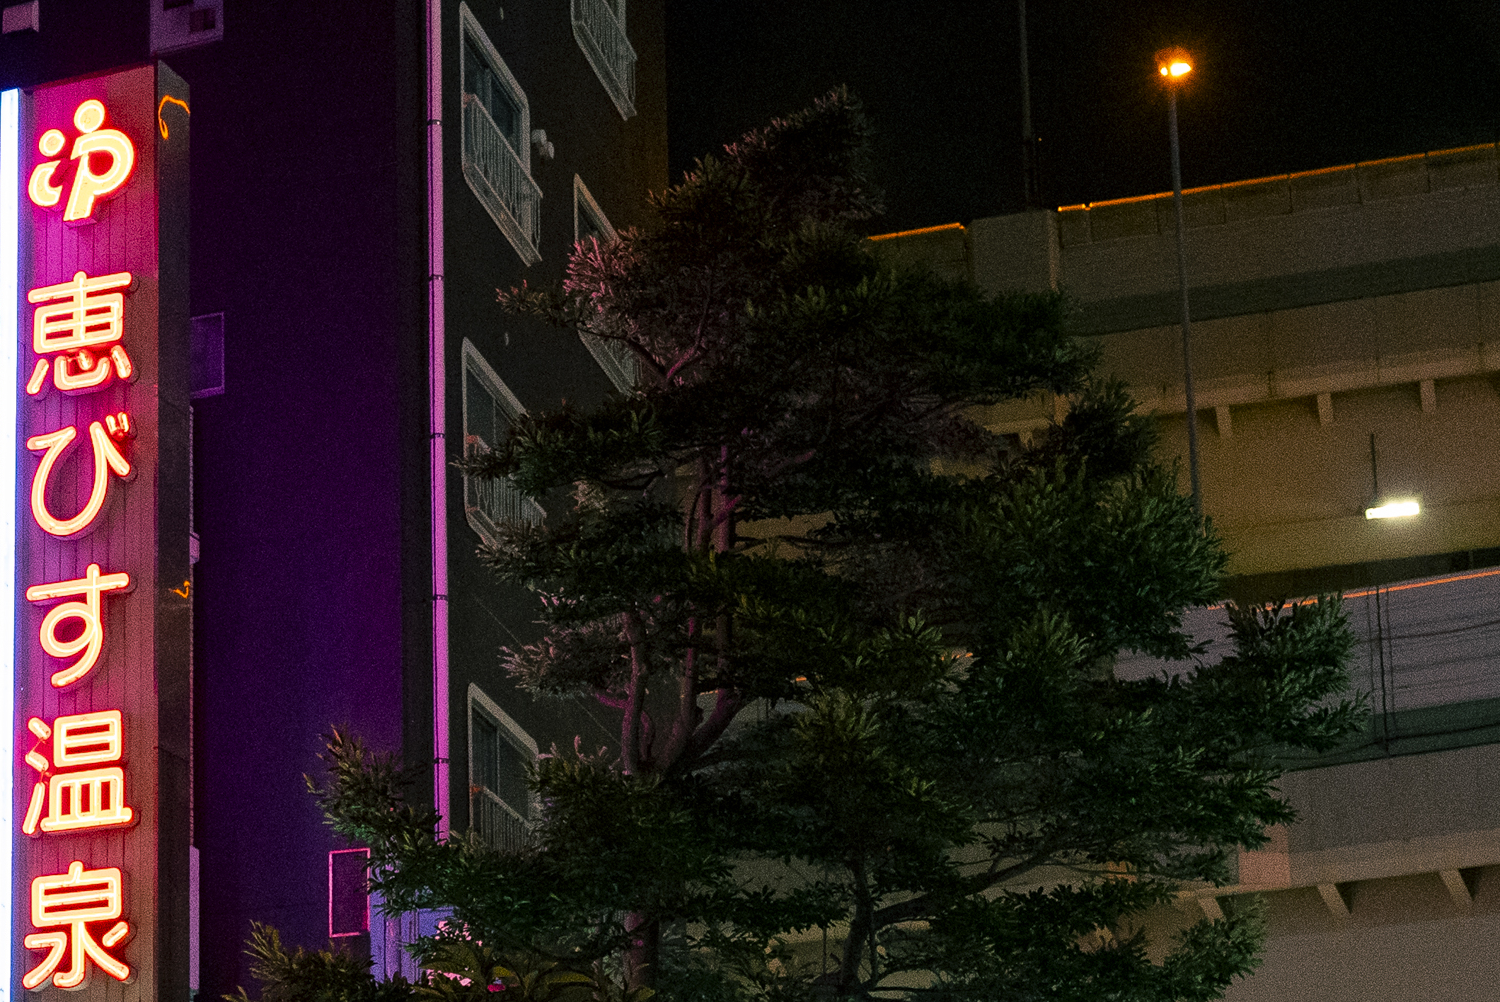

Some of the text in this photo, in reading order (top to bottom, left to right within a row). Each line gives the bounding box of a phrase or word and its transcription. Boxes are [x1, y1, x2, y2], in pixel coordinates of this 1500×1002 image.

[22, 270, 135, 992] 恵びす温泉
